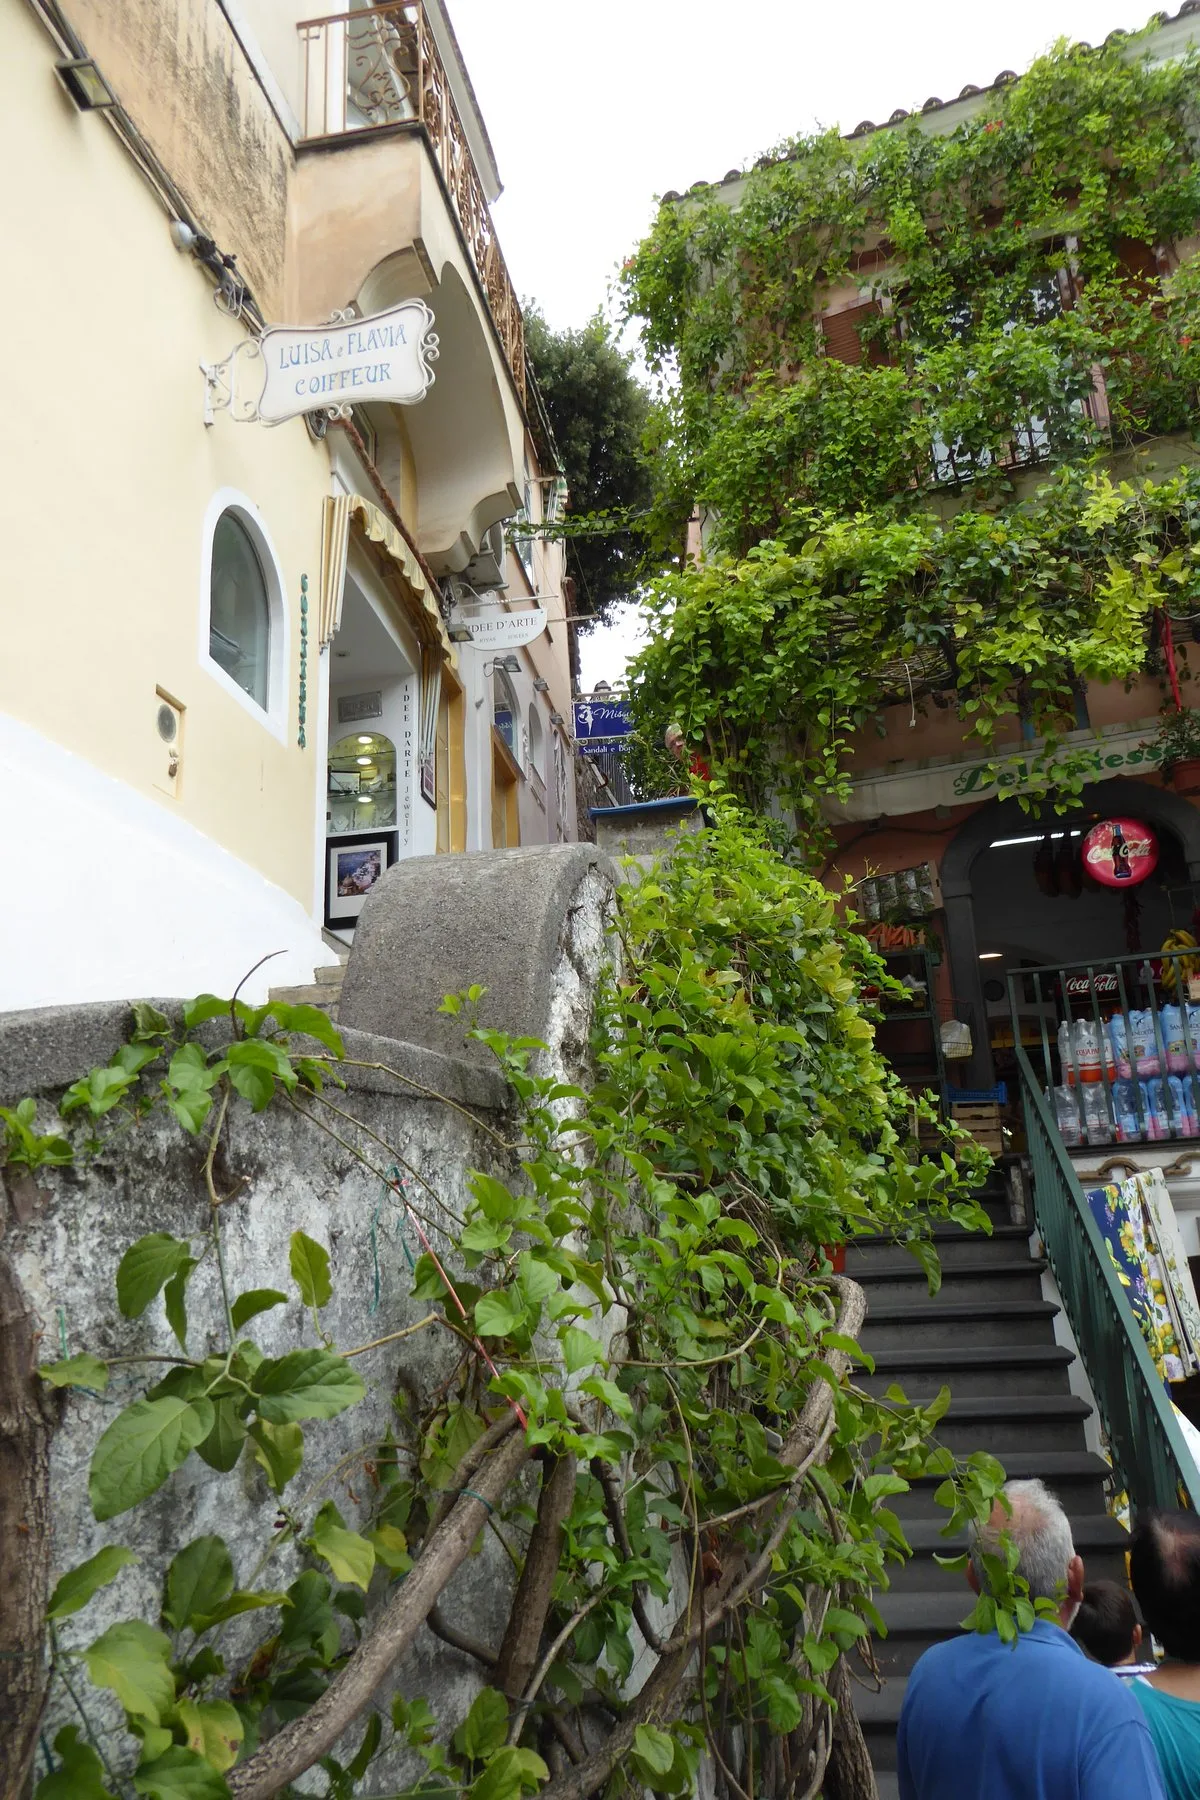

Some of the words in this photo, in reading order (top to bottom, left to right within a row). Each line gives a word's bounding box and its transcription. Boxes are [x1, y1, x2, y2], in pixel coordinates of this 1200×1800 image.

[279, 338, 332, 370] LUISA
[336, 346, 344, 358] e
[347, 324, 408, 355] FLAVIA
[295, 362, 392, 396] COIFFEUR
[496, 617, 538, 630] D'ARTE
[583, 745, 608, 754] Sandali
